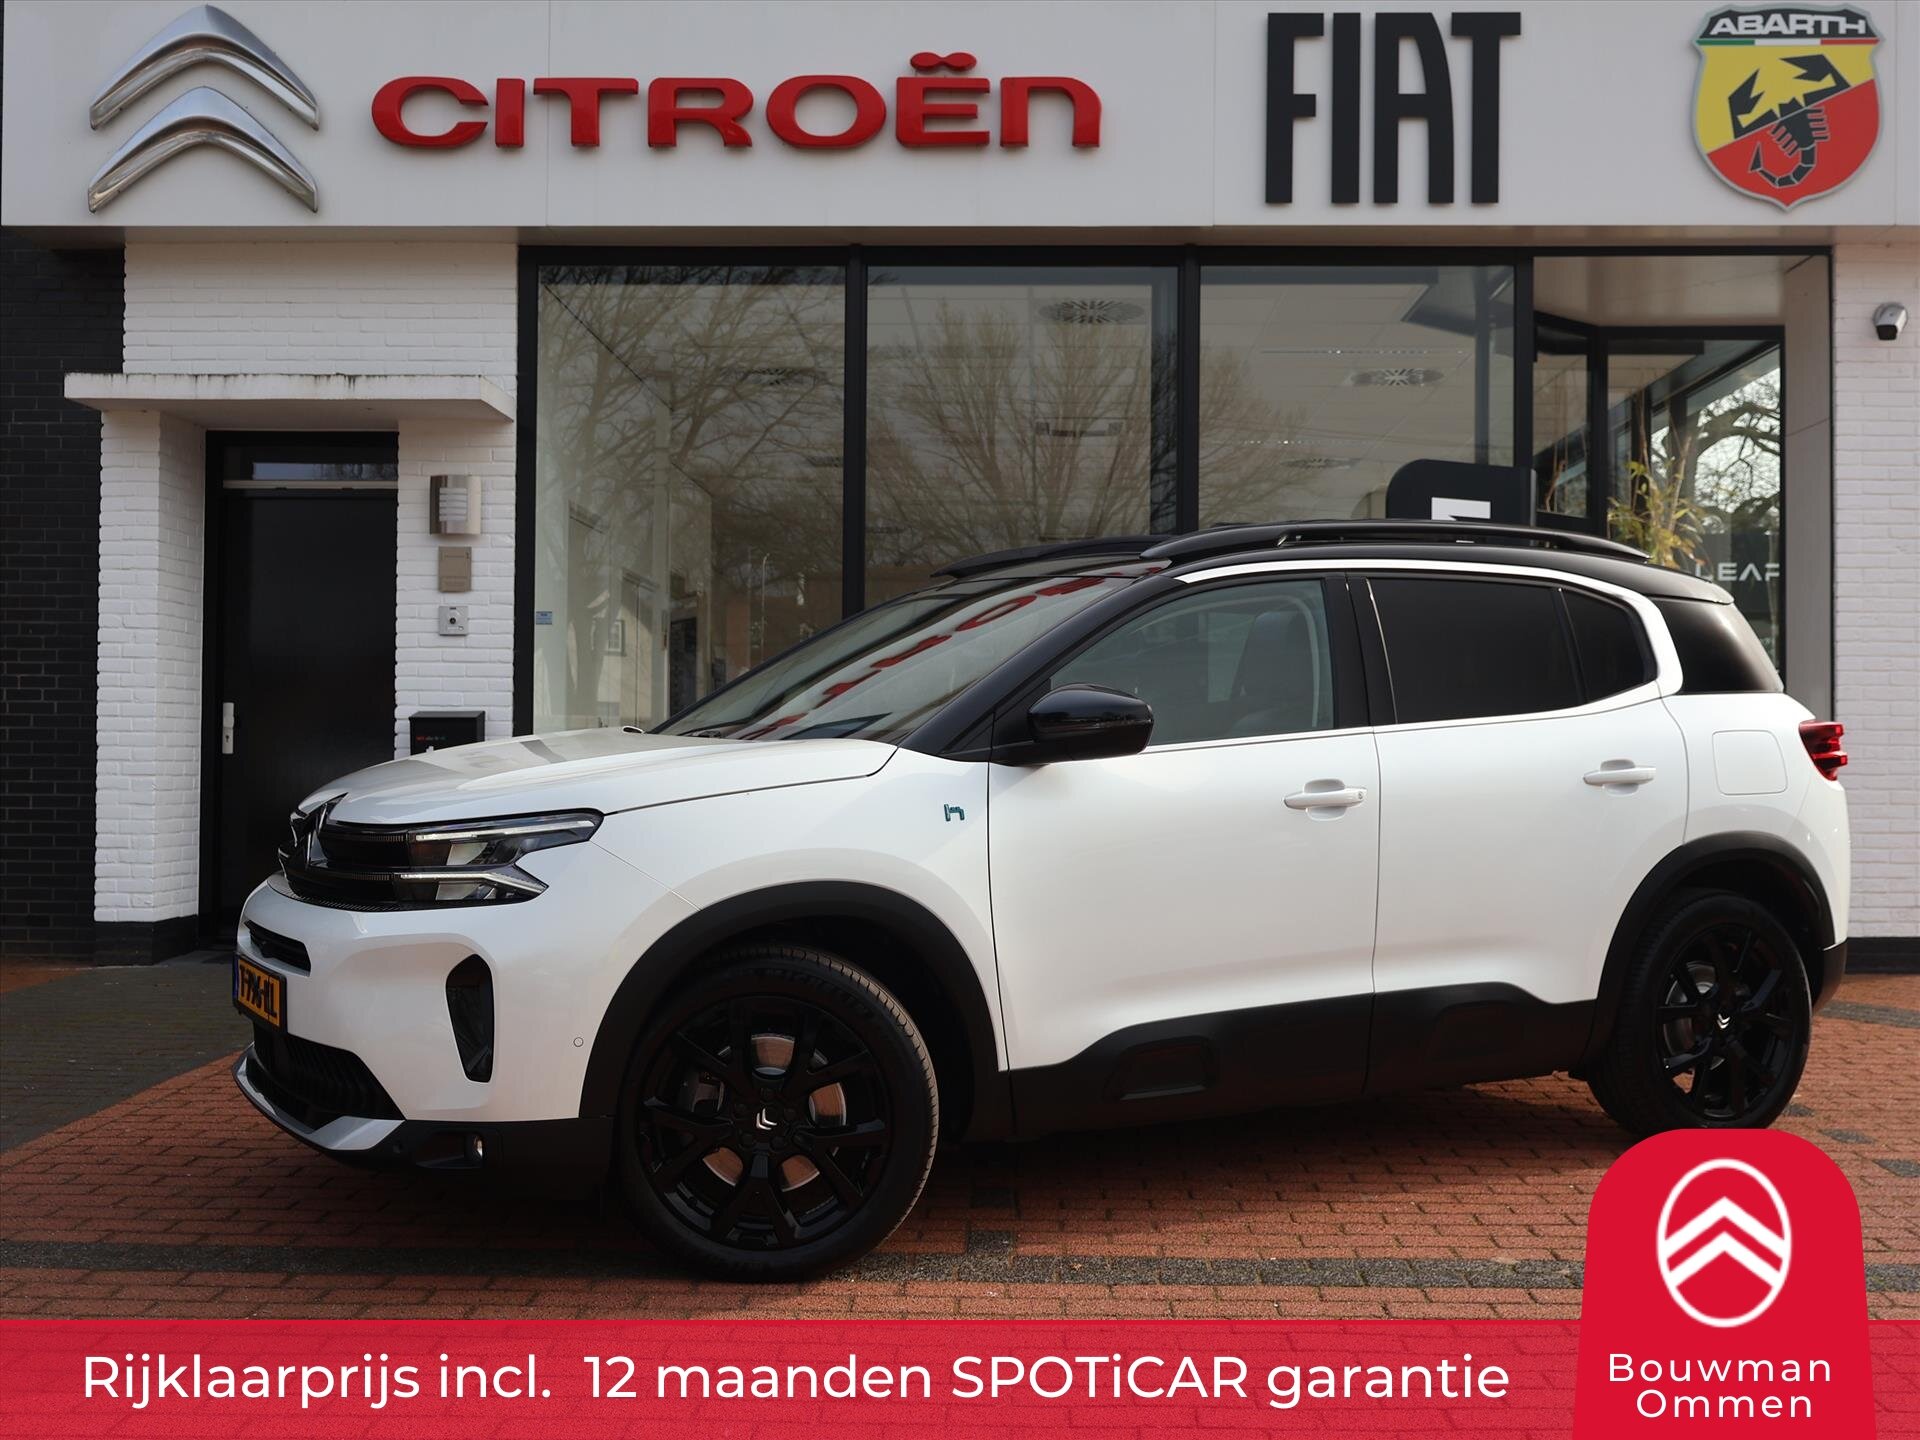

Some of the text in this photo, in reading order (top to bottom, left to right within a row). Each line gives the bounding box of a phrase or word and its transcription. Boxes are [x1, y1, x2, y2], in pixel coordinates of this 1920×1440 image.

[1710, 13, 1866, 35] ABARTH
[371, 52, 1102, 148] CITROËN
[1266, 12, 1521, 204] FIAT
